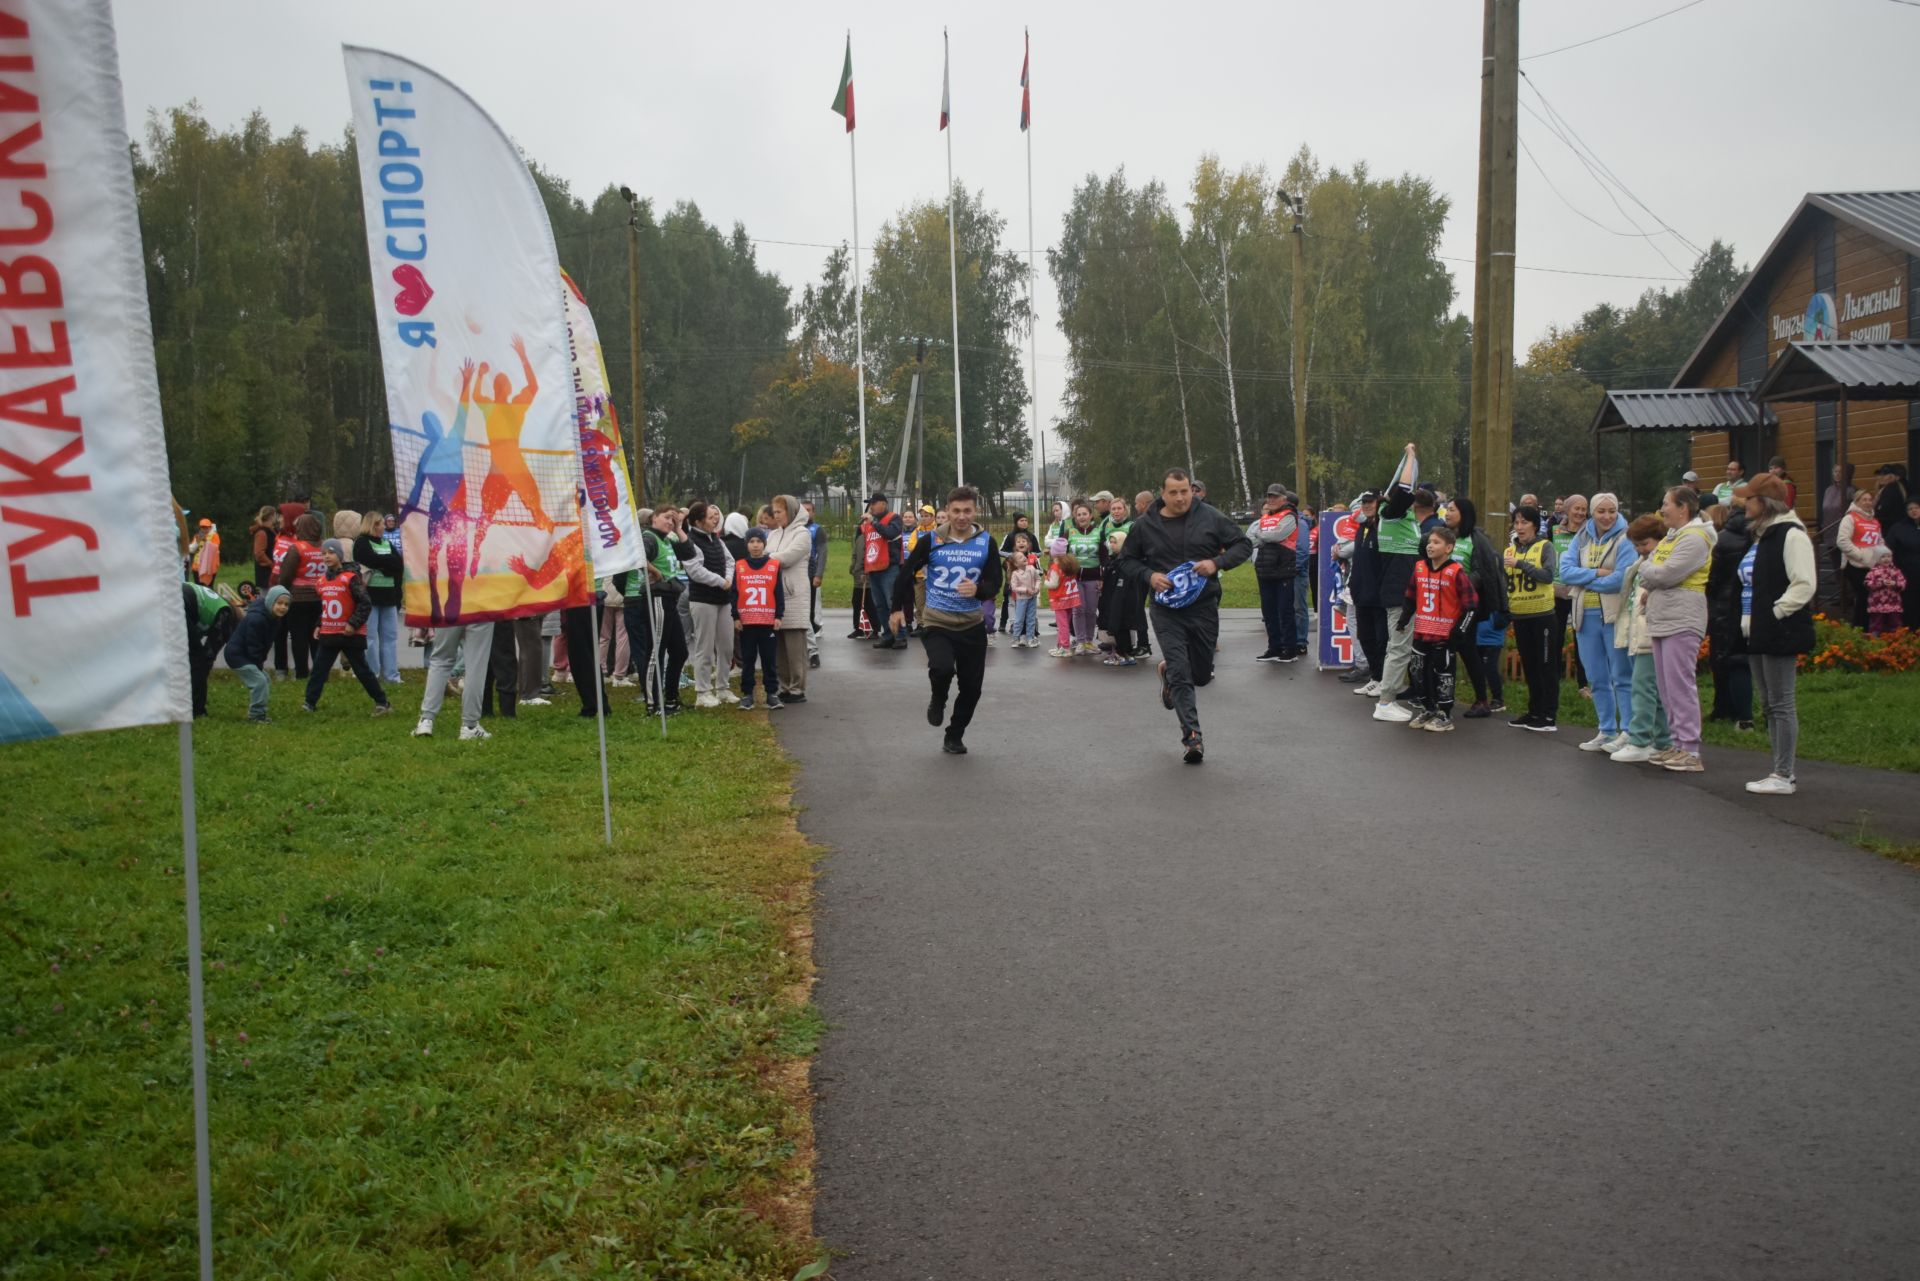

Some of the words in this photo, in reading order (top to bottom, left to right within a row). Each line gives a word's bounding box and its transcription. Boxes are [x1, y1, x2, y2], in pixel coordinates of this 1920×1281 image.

[369, 79, 428, 261] СПОРТ!
[1841, 276, 1901, 323] Лыжный
[397, 320, 437, 349] Я
[1861, 531, 1880, 545] 47
[305, 562, 328, 578] 29
[933, 565, 981, 589] 222
[745, 587, 767, 606] 21
[1421, 592, 1436, 613] 3
